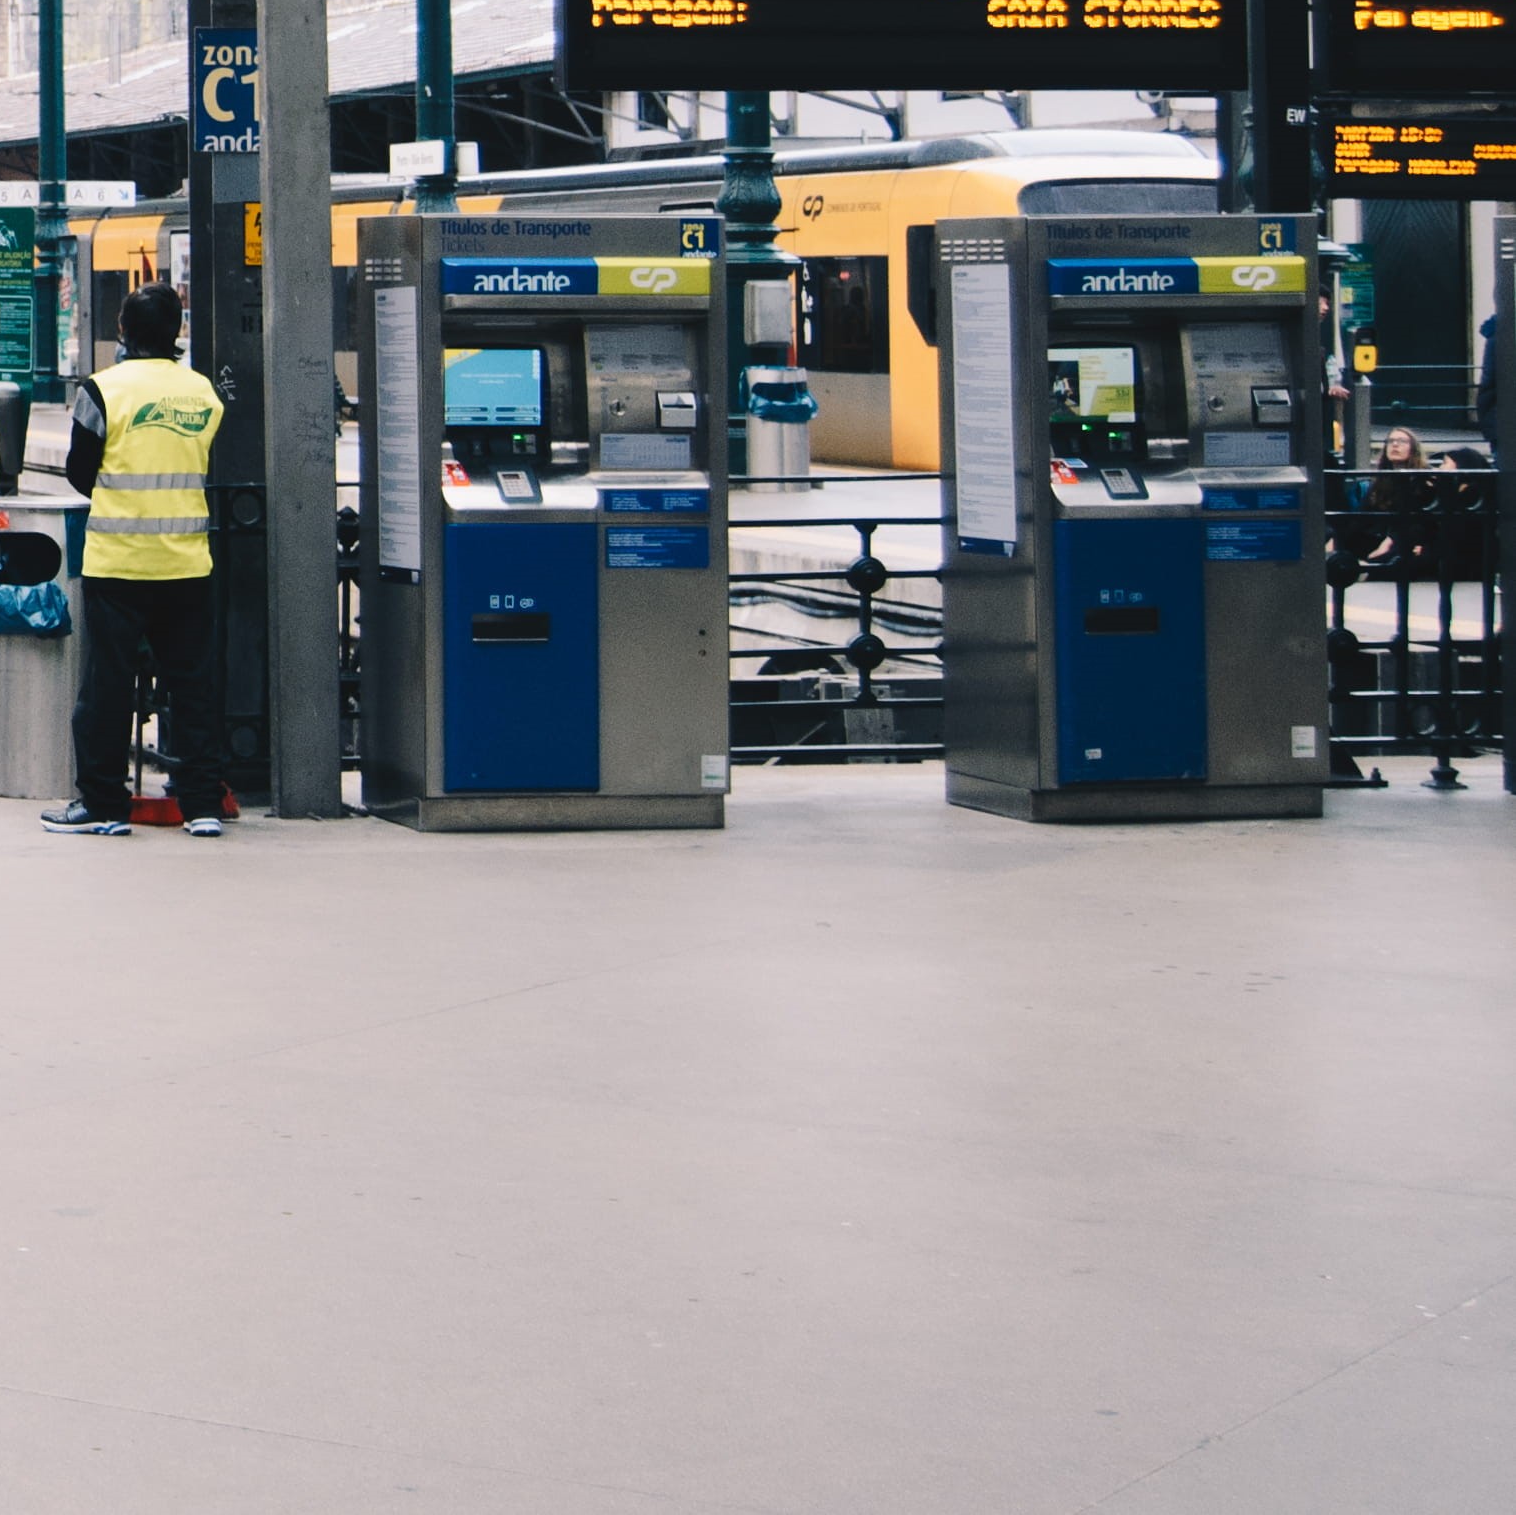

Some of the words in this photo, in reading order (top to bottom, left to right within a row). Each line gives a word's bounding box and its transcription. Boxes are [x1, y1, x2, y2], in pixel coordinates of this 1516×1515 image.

[491, 220, 510, 236] de
[514, 220, 592, 239] Transporte
[682, 231, 705, 249] C1
[1260, 230, 1283, 249] C1
[473, 267, 571, 292] andante
[1081, 268, 1175, 292] andante
